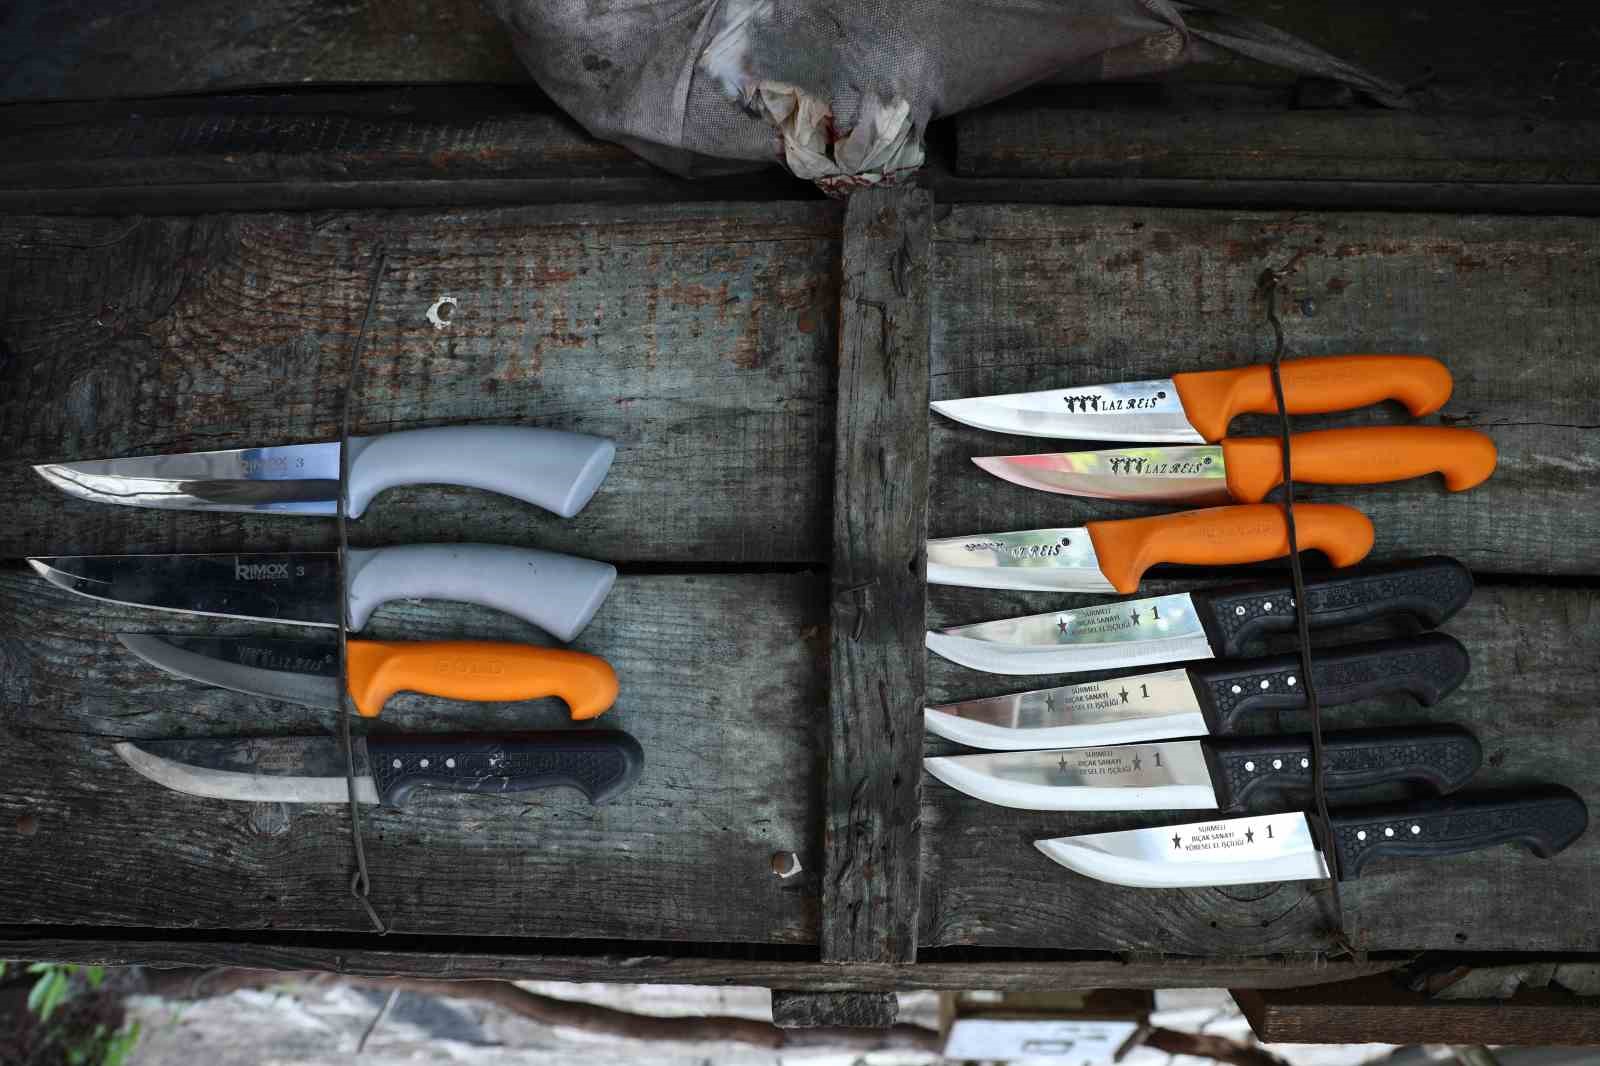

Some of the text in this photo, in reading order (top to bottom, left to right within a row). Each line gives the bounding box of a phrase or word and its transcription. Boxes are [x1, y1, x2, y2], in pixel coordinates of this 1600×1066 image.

[1102, 399, 1123, 411] LAZ
[296, 456, 304, 469] 3
[1145, 463, 1168, 474] LAZ
[234, 555, 289, 581] RIMOX
[295, 566, 305, 577] 3
[1151, 605, 1161, 620] 1
[1139, 683, 1150, 698] 1
[1153, 752, 1163, 767] 1
[1264, 823, 1275, 839] 1
